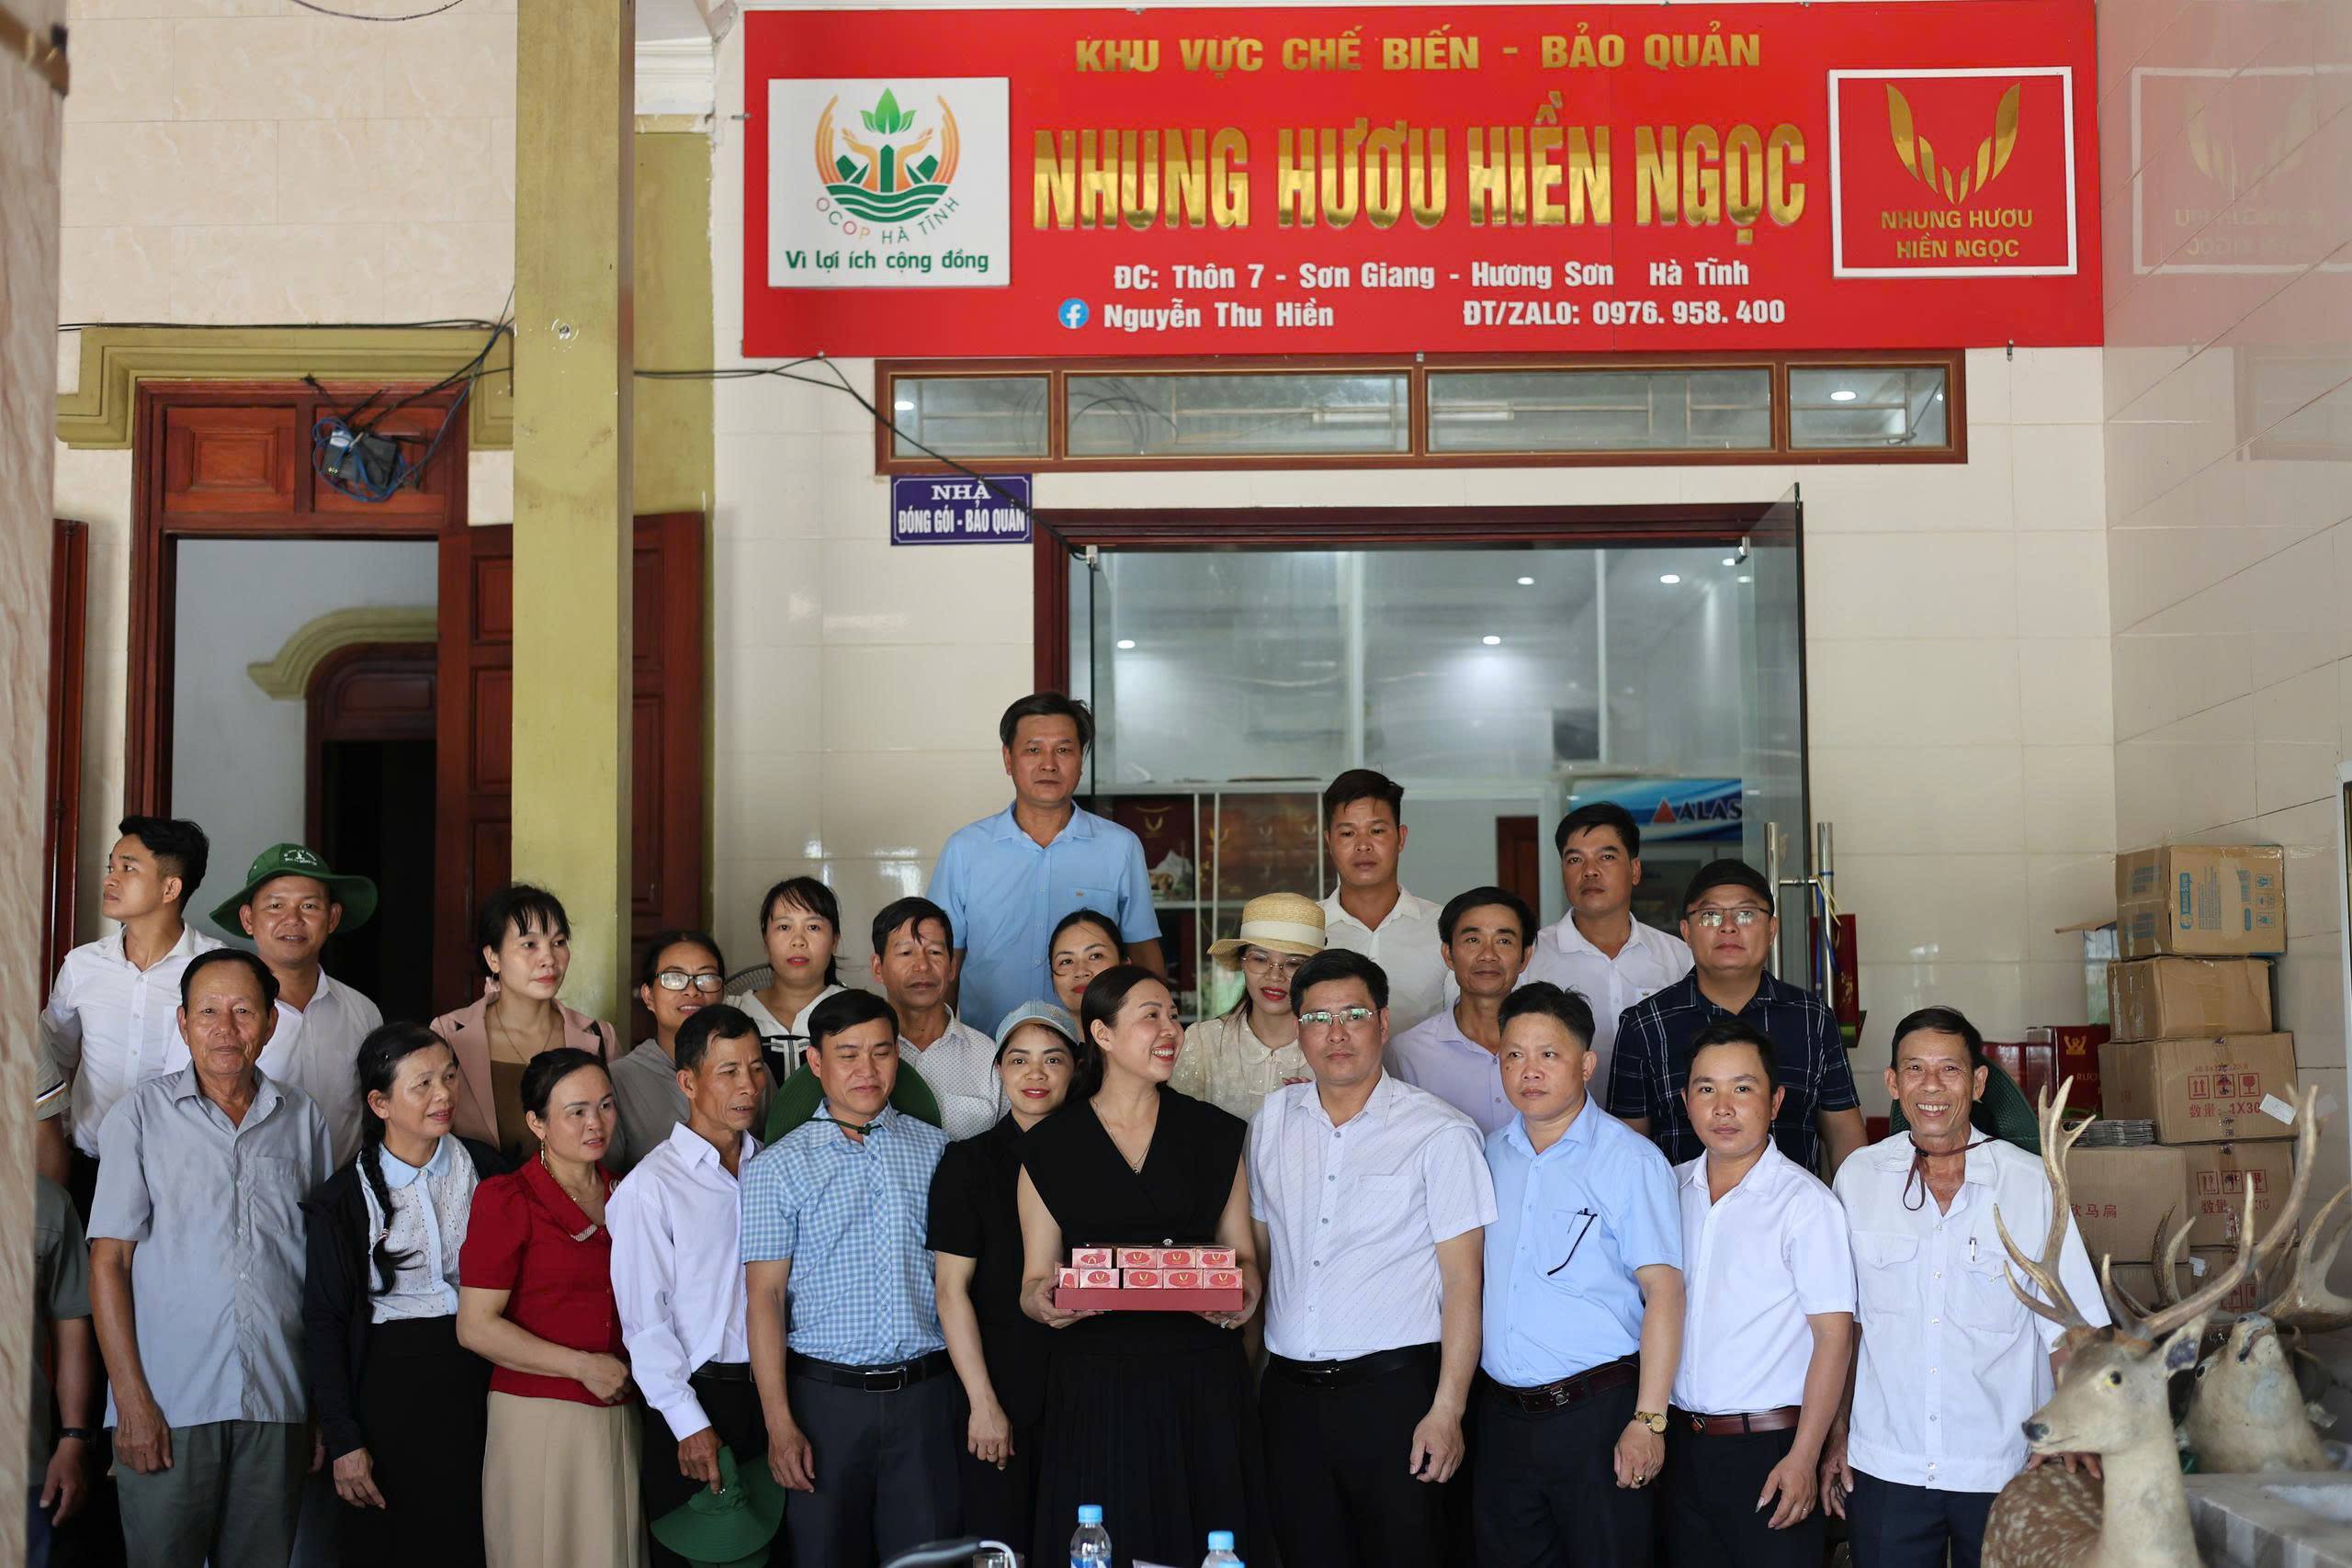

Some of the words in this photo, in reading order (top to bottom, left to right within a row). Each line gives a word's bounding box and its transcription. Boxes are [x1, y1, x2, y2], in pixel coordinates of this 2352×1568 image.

[1075, 39, 1160, 73] KHU
[1180, 36, 1264, 80] VỰC
[1282, 26, 1363, 72] CHẾ
[1382, 24, 1479, 71] BIẾN
[1541, 22, 1625, 69] BẢO
[1644, 20, 1760, 71] QUẢN
[1033, 126, 1250, 231] NHUNG
[1278, 118, 1449, 229] HƯƠU
[1466, 90, 1613, 227] HIỀN
[1634, 122, 1806, 246] NGỌC
[816, 197, 871, 241] OCOP
[881, 227, 910, 244] HÀ
[1881, 209, 1962, 230] NHUNG
[1969, 208, 2033, 229] HƯƠU
[785, 250, 808, 269] Vì
[816, 250, 840, 274] lợi
[848, 250, 876, 269] ích
[886, 251, 933, 274] cộng
[941, 249, 989, 274] đồng
[1896, 231, 1948, 259] HIỀN
[1954, 239, 2019, 263] NGỌC
[1114, 265, 1159, 289] ĐC:
[1171, 263, 1236, 289] Thôn
[1247, 264, 1265, 289] 7
[1298, 262, 1351, 288] Sơn
[1361, 262, 1435, 290] Giang
[1471, 261, 1553, 289] Hương
[1564, 260, 1615, 287] Sơn
[1649, 258, 1683, 287] Hà
[1693, 257, 1750, 286] Tĩnh
[1103, 298, 1202, 333] Nguyễn
[1214, 301, 1262, 328] Thu
[1275, 298, 1334, 327] Hiền
[1463, 300, 1581, 326] ĐT/ZALO:
[1592, 300, 1666, 325] 0976.
[1672, 300, 1729, 324] 958.
[1736, 299, 1786, 324] 400
[898, 505, 932, 534] ĐÓNG
[933, 504, 956, 533] GÓI
[965, 499, 990, 533] BẢO
